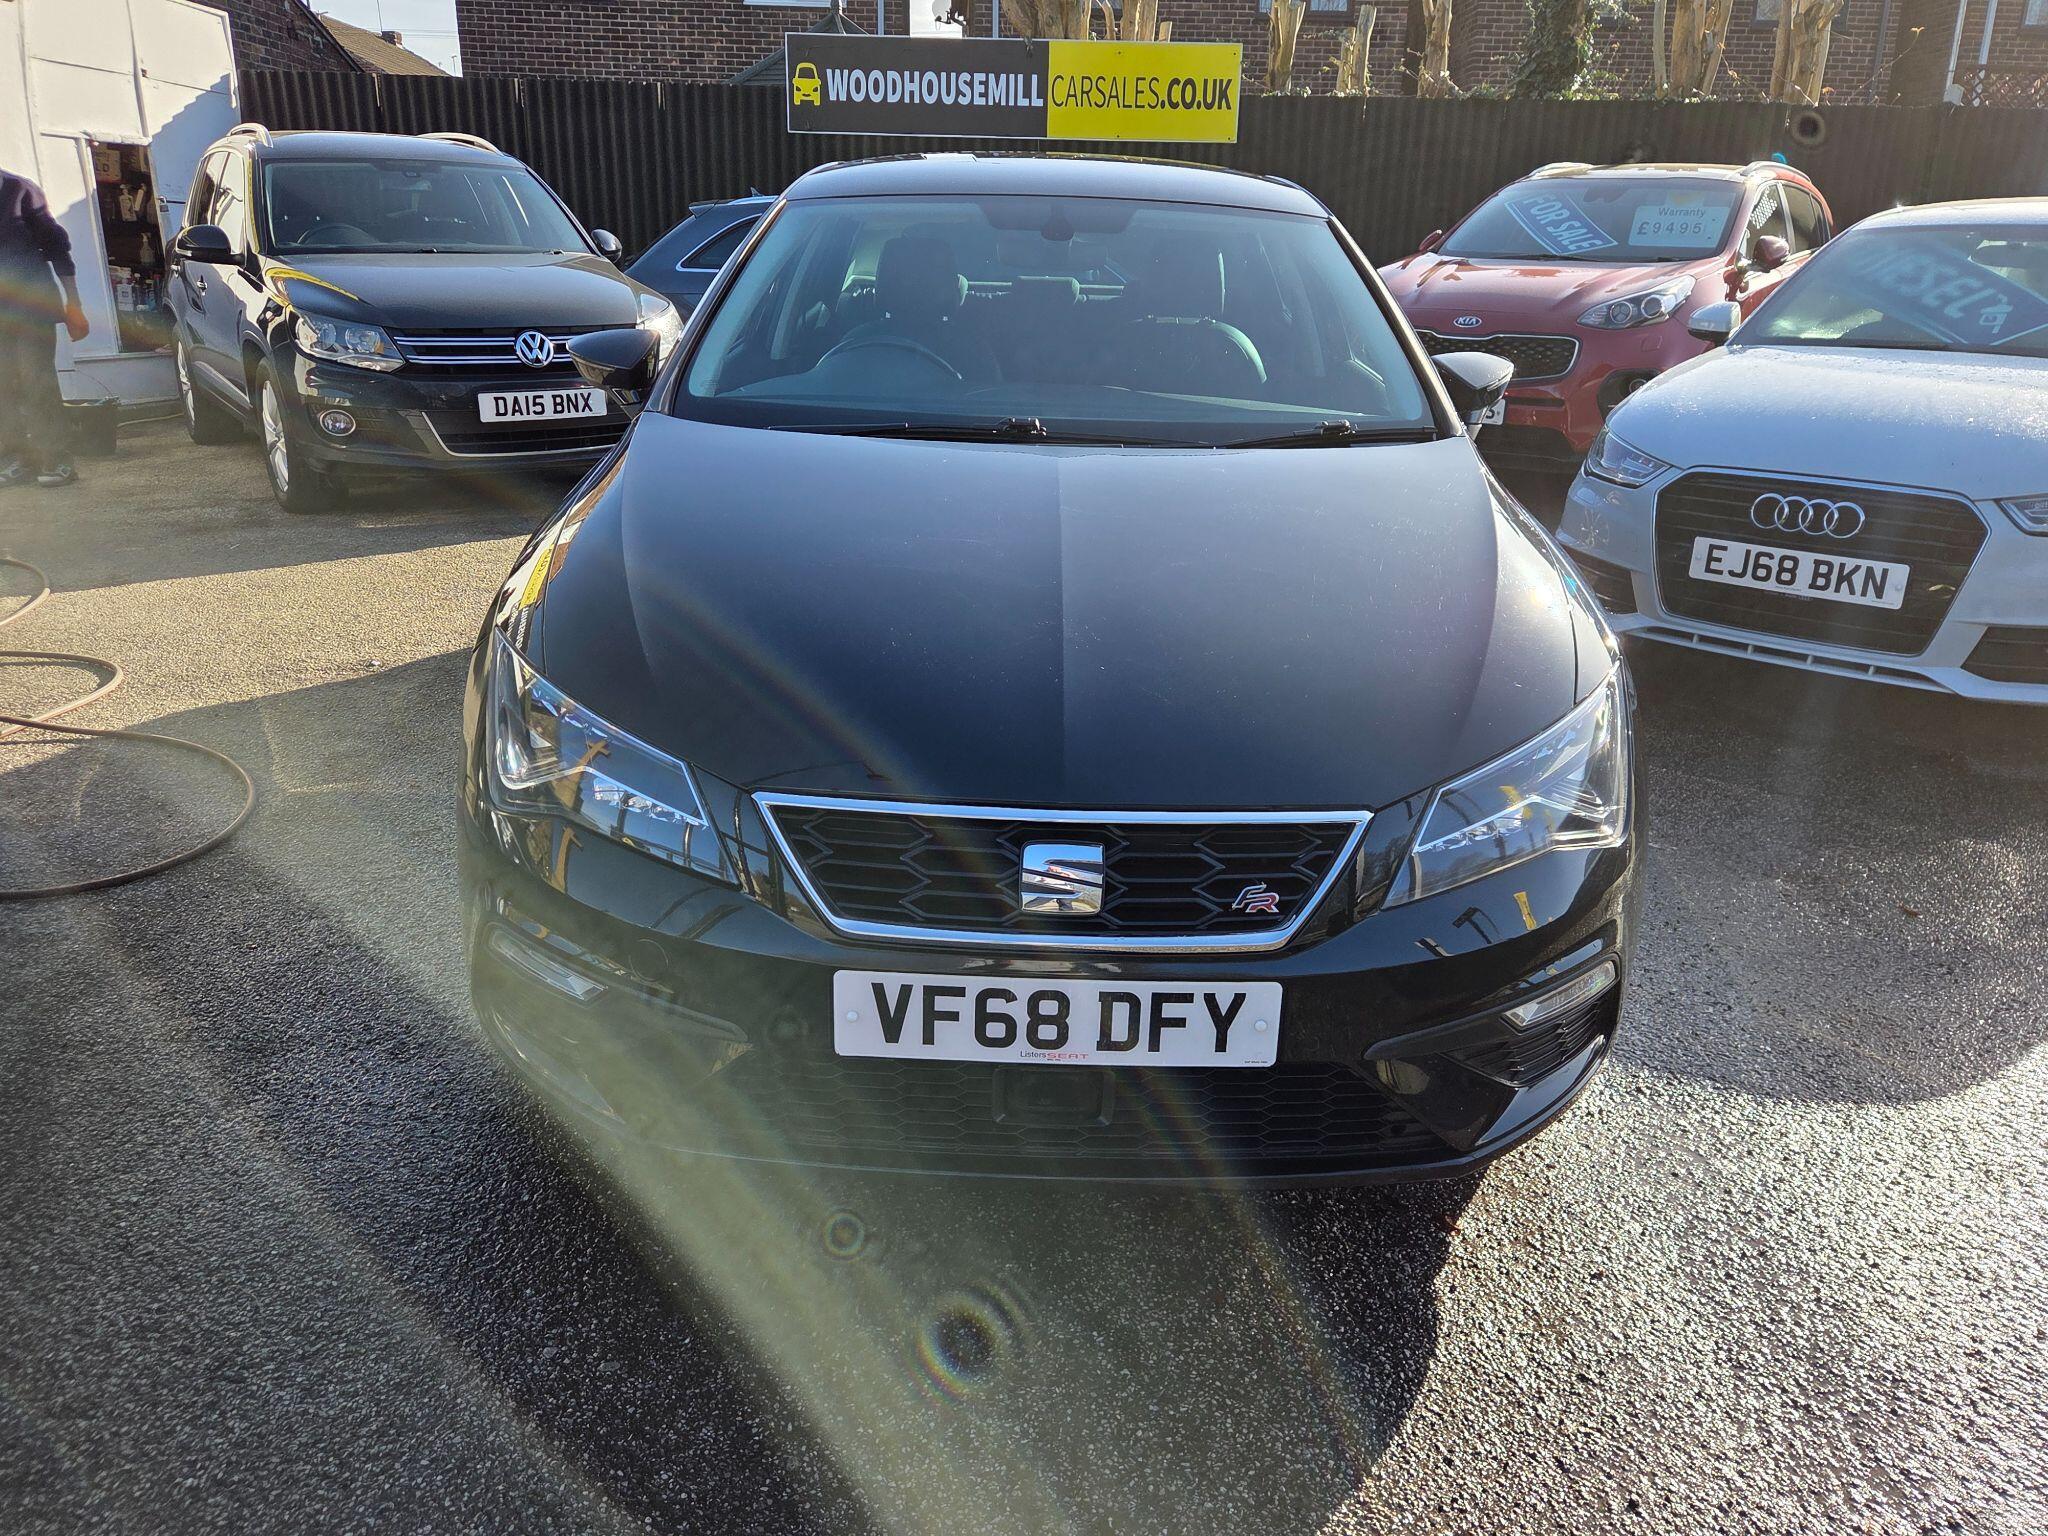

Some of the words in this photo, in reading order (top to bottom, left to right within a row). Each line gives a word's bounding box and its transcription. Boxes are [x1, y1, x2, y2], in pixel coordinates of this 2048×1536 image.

[826, 68, 1044, 107] WOODHOUSEMILL
[1051, 74, 1233, 111] CARSALES.CO.UK
[1523, 193, 1570, 224] FOR
[1657, 207, 1707, 219] Warranty
[1546, 220, 1604, 251] SALE
[1637, 221, 1702, 235] £9495
[1457, 316, 1476, 325] KIA
[493, 395, 545, 417] DA15
[551, 392, 593, 414] BNX
[1704, 543, 1800, 586] EJ68
[1808, 558, 1889, 600] BKN
[871, 982, 1071, 1050] VF68
[1096, 990, 1247, 1053] DFY
